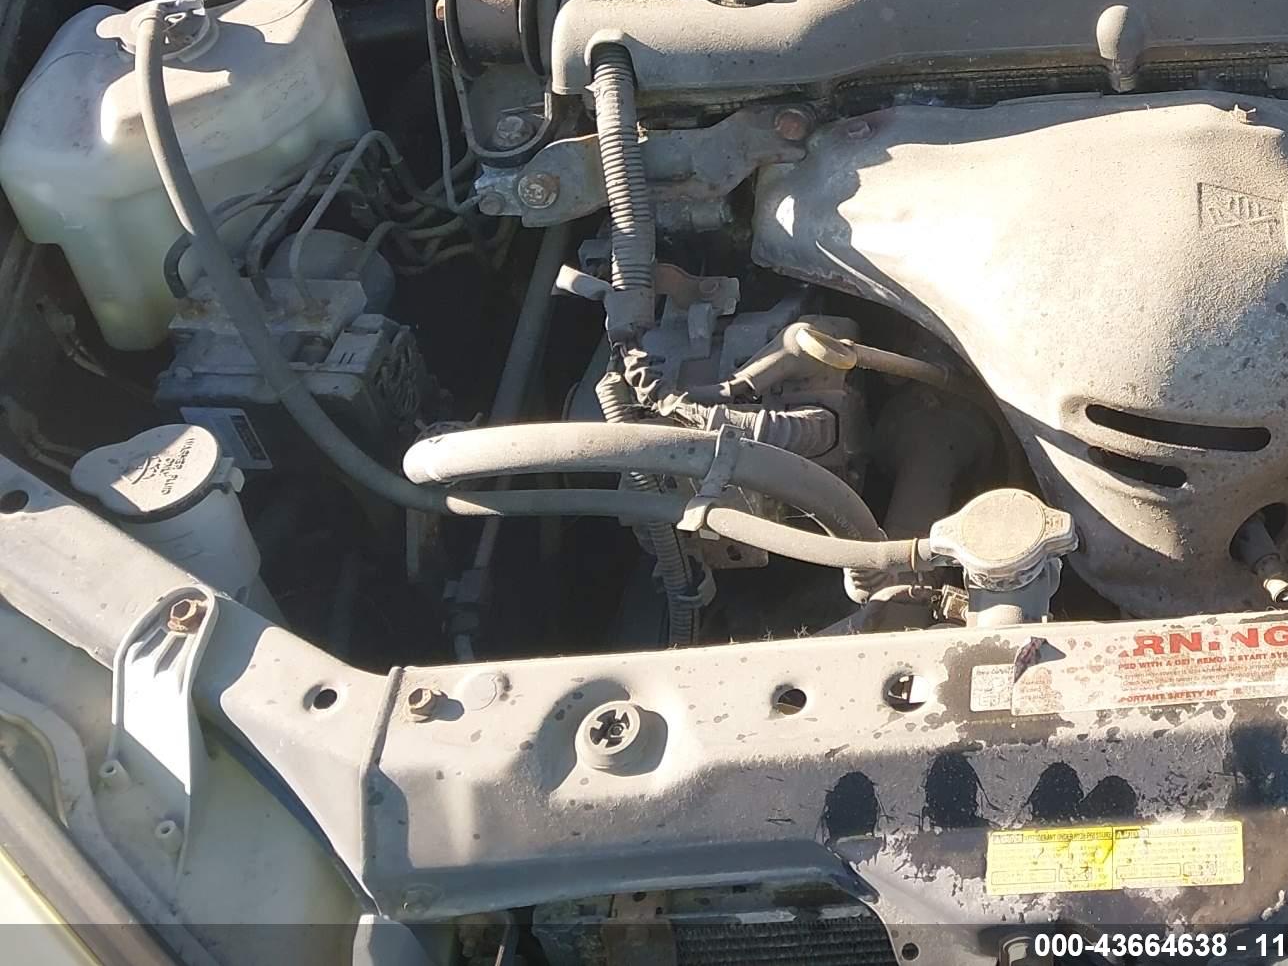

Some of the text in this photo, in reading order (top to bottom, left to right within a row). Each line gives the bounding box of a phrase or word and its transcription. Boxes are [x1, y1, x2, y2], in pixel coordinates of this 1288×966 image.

[161, 473, 179, 495] FLUID
[1138, 660, 1163, 669] WITH
[1237, 652, 1268, 662] START
[1168, 690, 1205, 700] SAFETY
